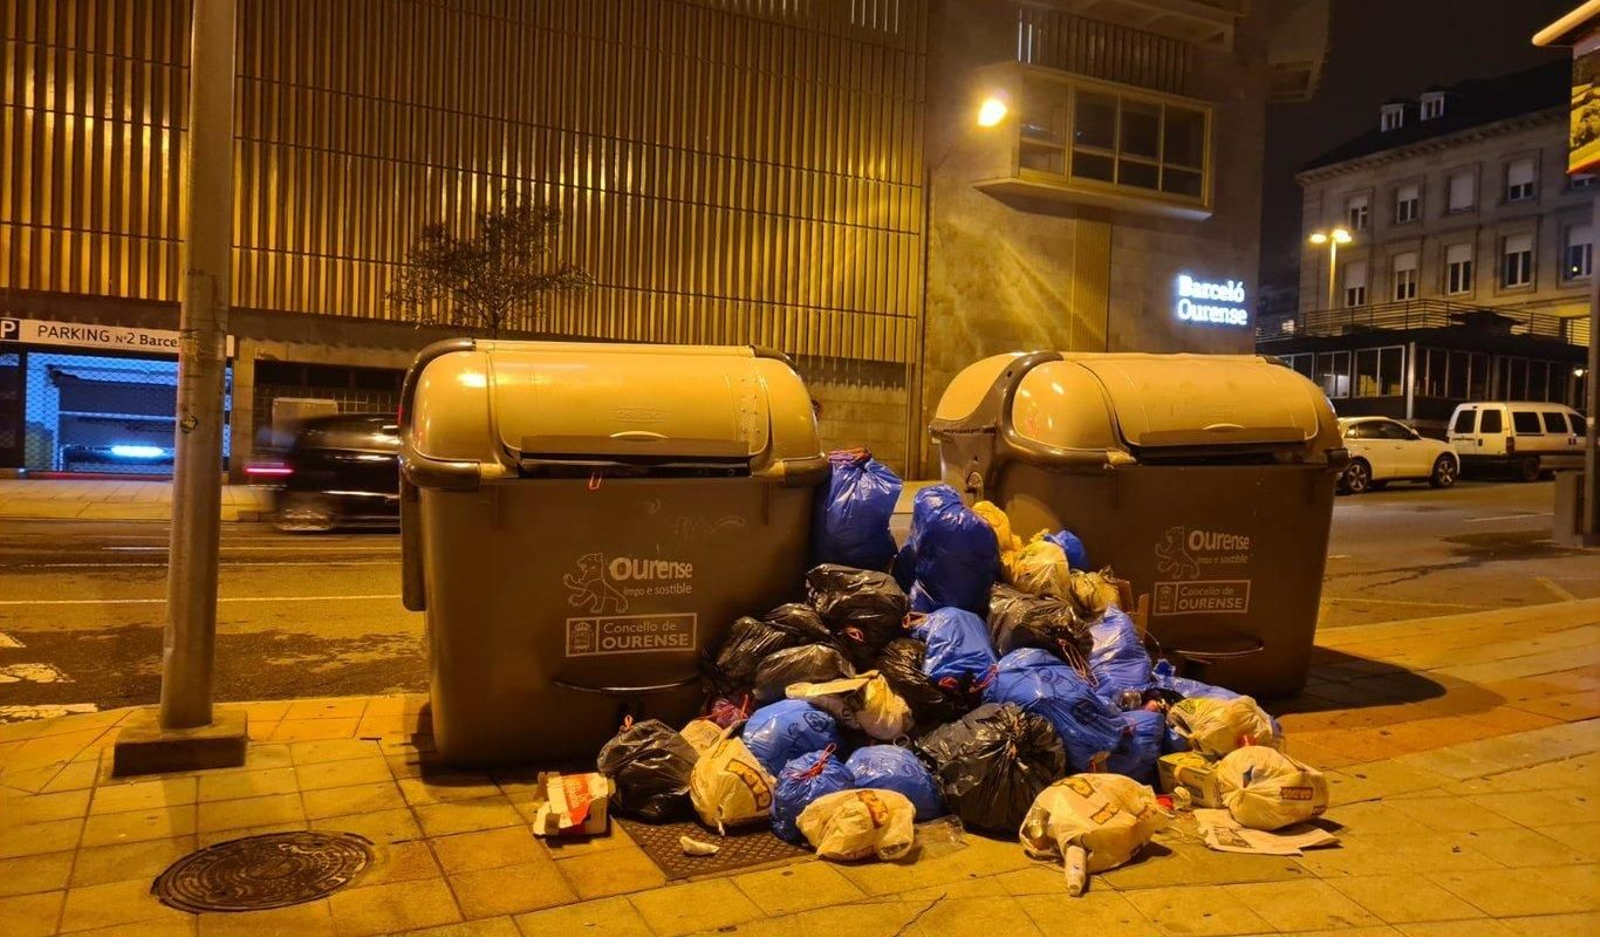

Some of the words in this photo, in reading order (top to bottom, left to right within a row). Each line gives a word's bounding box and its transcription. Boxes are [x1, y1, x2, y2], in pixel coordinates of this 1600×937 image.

[1179, 275, 1245, 303] Barceló
[1178, 298, 1248, 326] Ourense
[0, 321, 16, 338] P
[38, 325, 110, 343] PARKING
[139, 334, 179, 348] Barce
[1188, 530, 1250, 551] Ourense
[609, 557, 693, 581] Ourense
[1180, 585, 1219, 597] Concello
[1222, 586, 1234, 596] de
[1178, 597, 1243, 610] OURENSE
[603, 621, 658, 634] Concello
[662, 620, 678, 632] de
[602, 633, 689, 649] OURENSE
